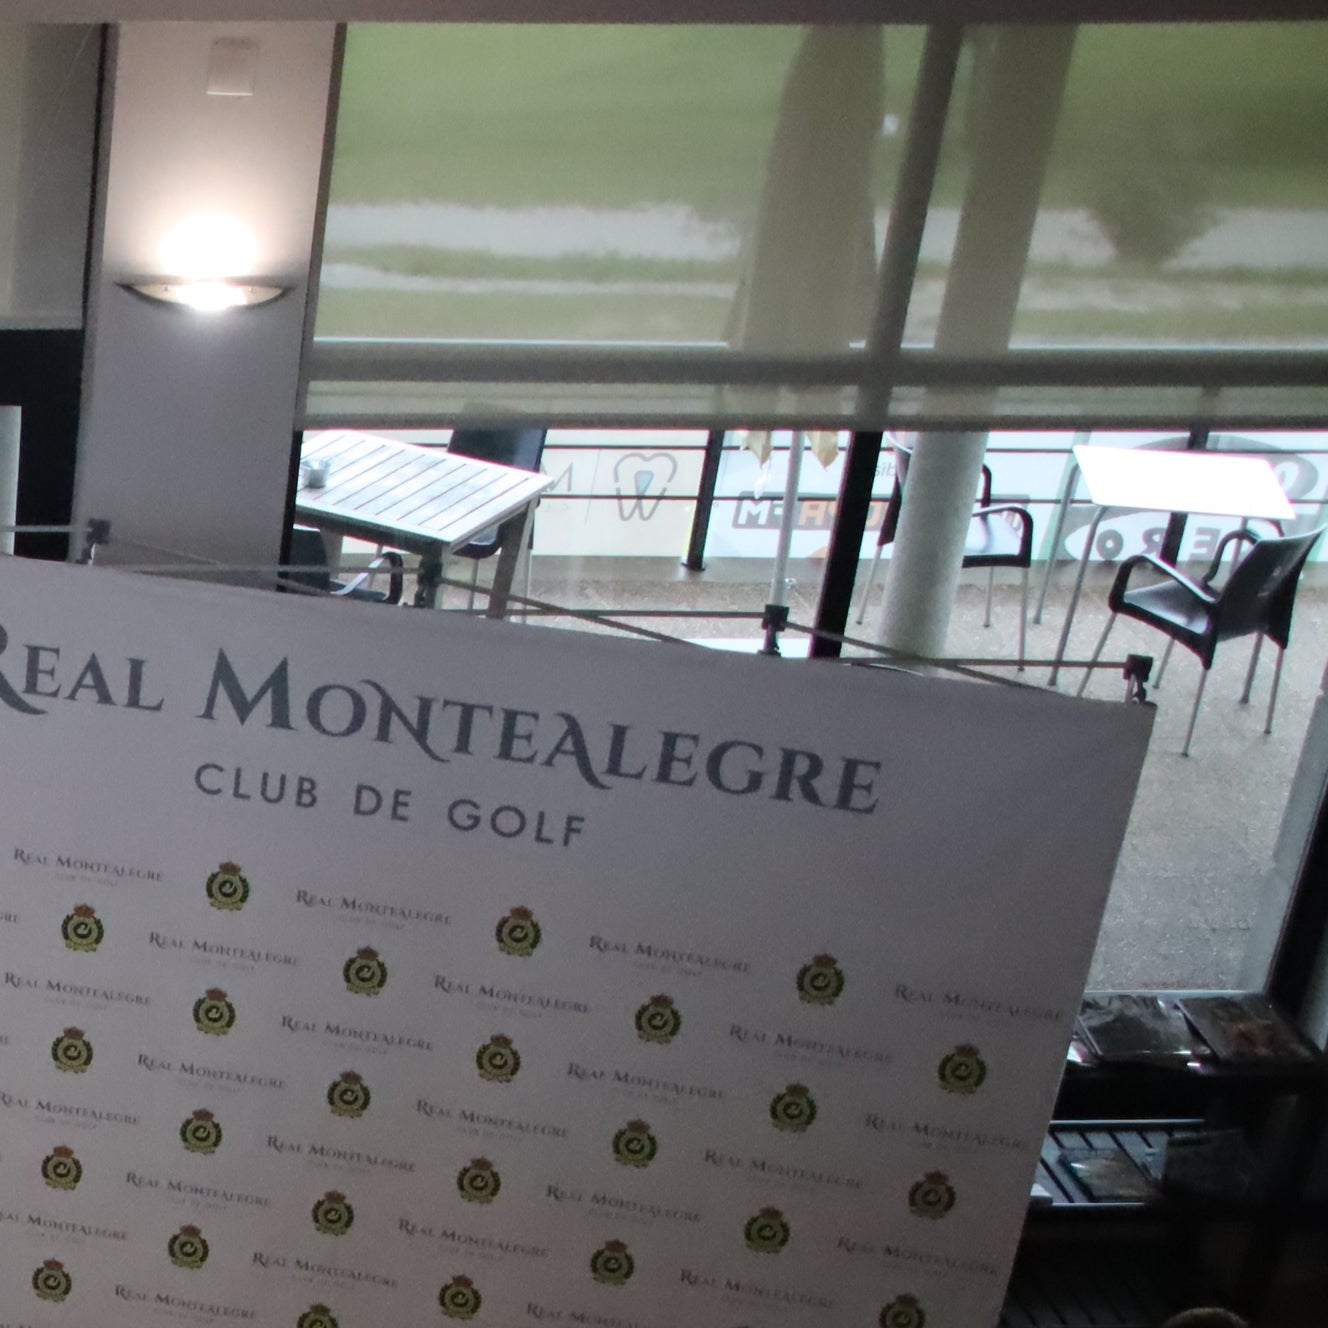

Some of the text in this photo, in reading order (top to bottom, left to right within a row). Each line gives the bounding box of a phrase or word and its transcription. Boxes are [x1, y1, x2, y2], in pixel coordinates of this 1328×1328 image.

[196, 647, 883, 816] MONTEALEGRE
[194, 763, 587, 848] CLUB DE GOLF
[14, 848, 161, 881] REAL MONTEALEGRE
[296, 889, 450, 924] REAL MONTEALEGRE
[149, 931, 298, 965] REAL MONTEALEGRE
[4, 971, 150, 1005] REAL MONTEALEGRE
[434, 975, 469, 995] REAL
[137, 1053, 171, 1071] REAL
[416, 1099, 451, 1119] REAL
